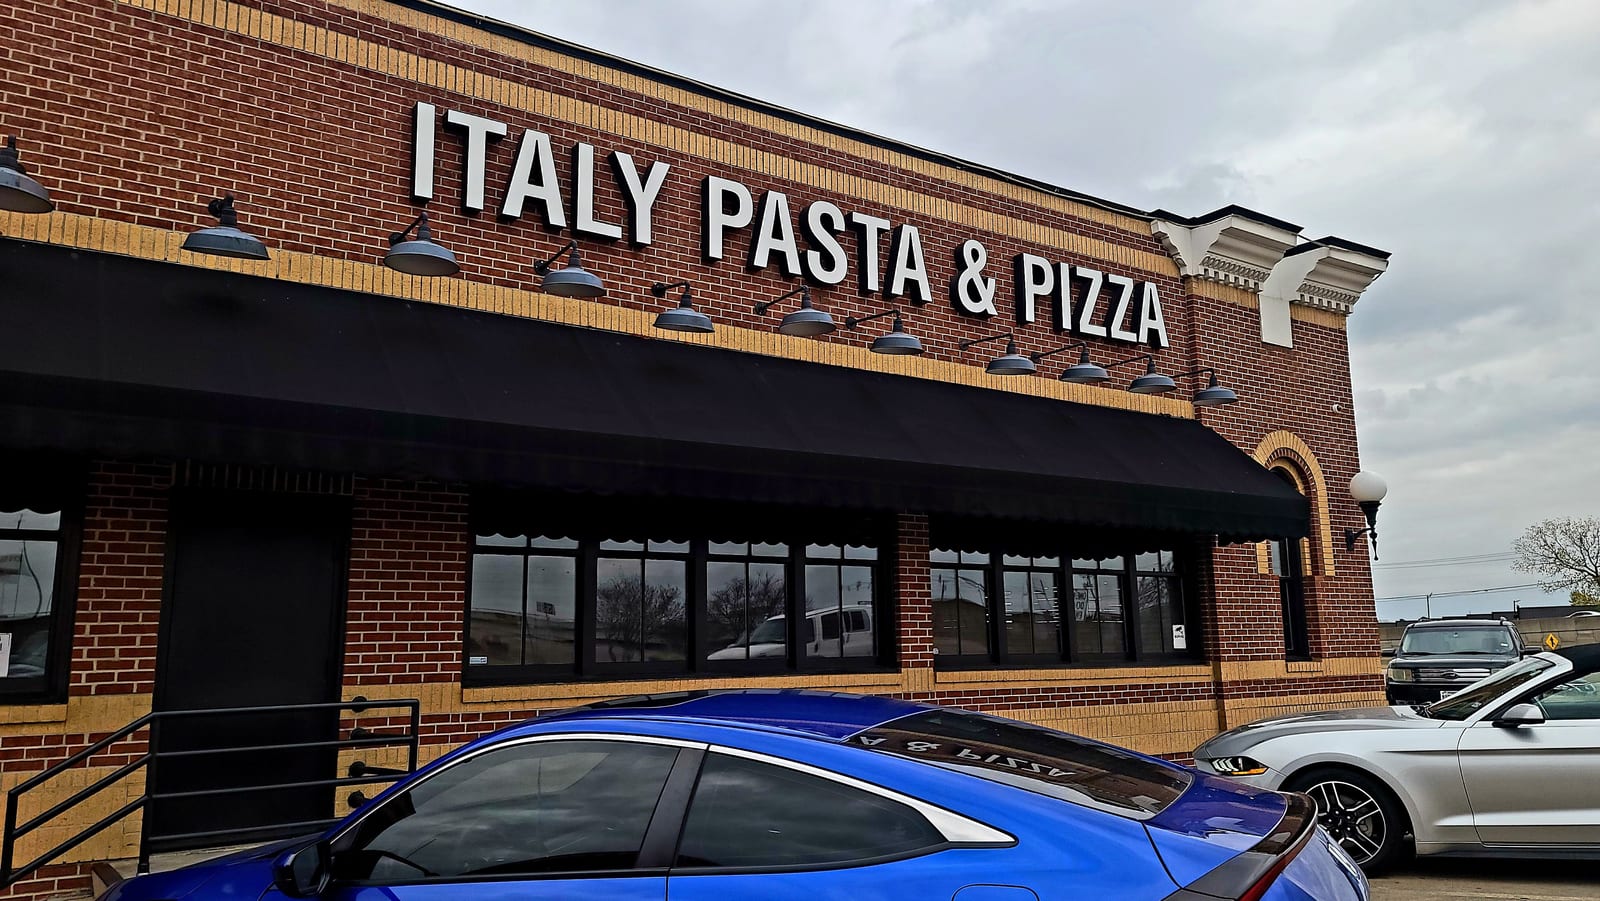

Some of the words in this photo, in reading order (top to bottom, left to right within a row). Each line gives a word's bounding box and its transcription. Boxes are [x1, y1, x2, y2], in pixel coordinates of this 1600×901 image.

[413, 101, 671, 246] ITALY
[707, 174, 933, 303] PASTA
[956, 238, 999, 317] &
[1019, 252, 1170, 349] PIZZA
